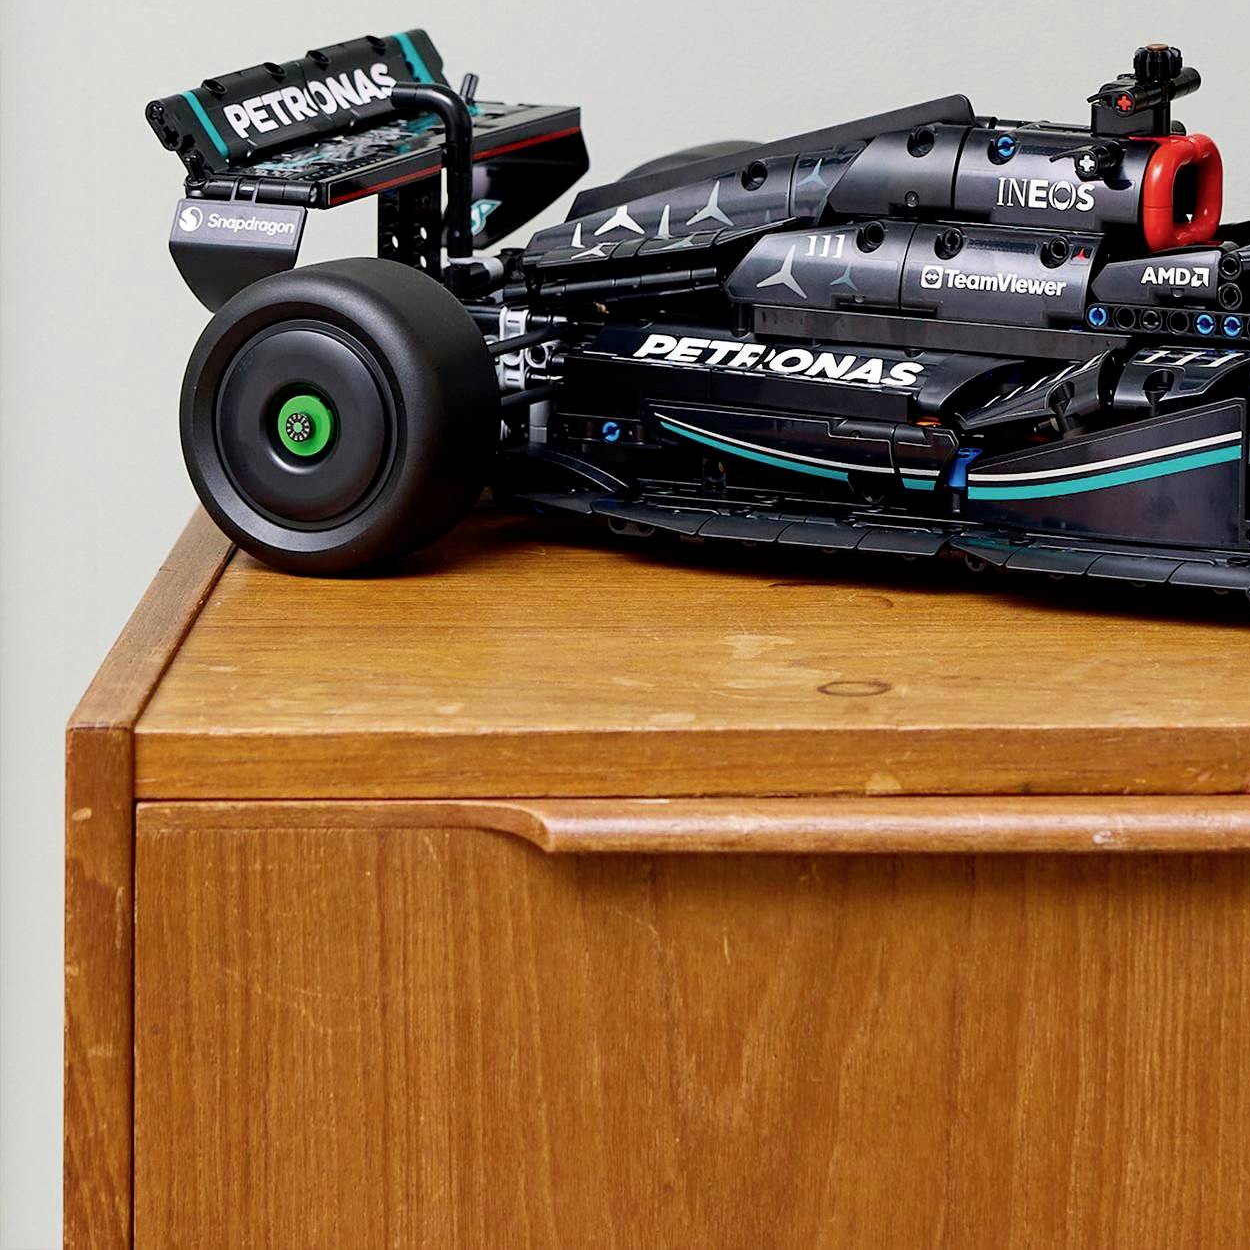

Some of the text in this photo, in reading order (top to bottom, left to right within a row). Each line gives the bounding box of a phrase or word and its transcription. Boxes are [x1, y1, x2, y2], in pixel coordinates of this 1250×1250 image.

[223, 62, 397, 139] PETRONAS
[996, 177, 1096, 211] INEOS
[207, 213, 296, 236] Snapdragon
[946, 268, 1067, 297] TeamViewer
[1140, 266, 1191, 286] AMD
[632, 333, 926, 386] PETRONAS
